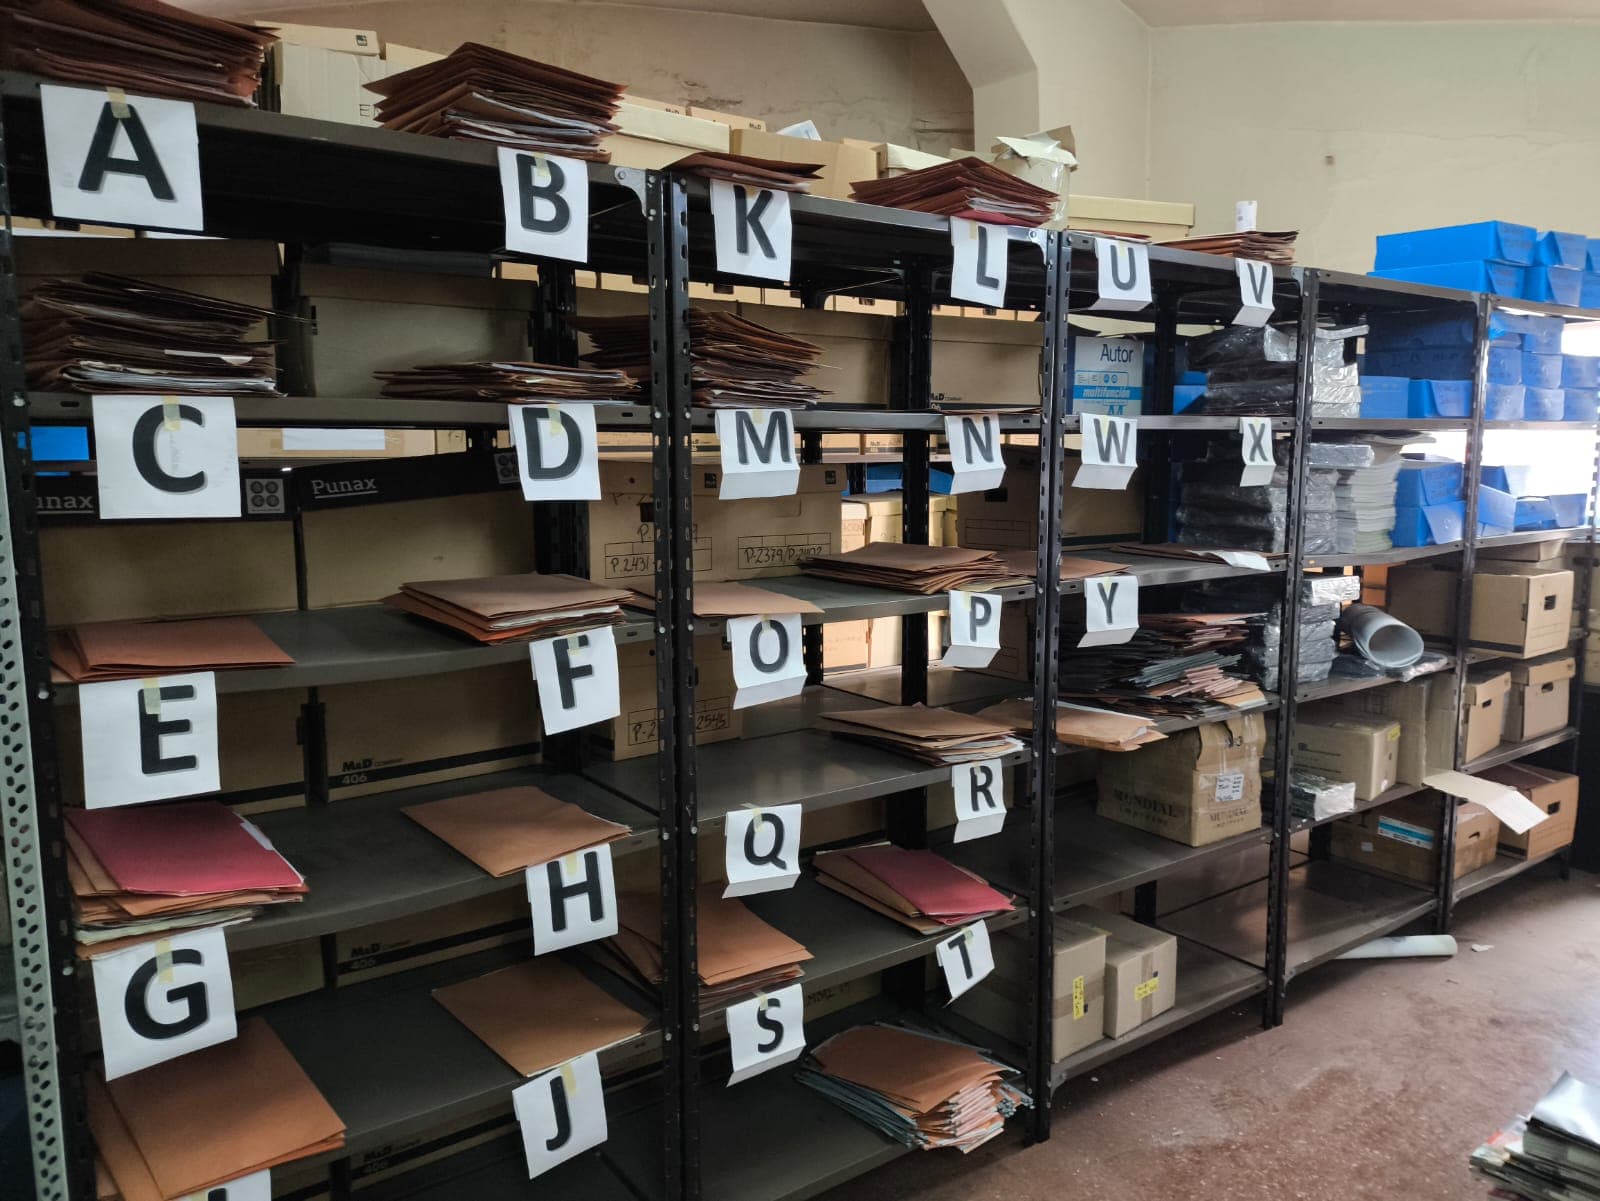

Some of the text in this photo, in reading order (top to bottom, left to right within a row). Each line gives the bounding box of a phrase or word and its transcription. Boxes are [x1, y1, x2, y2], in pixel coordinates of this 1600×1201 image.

[78, 102, 177, 200] A
[517, 153, 571, 233] B
[733, 185, 777, 259] K
[975, 226, 1000, 289] L
[1109, 244, 1136, 291] U
[1248, 264, 1268, 304] V
[1101, 344, 1134, 362] Autor
[133, 405, 207, 492] C
[521, 406, 583, 481] D
[735, 411, 792, 464] M
[963, 417, 995, 465] N
[1094, 418, 1130, 464] W
[1248, 423, 1269, 463] X
[312, 478, 377, 495] Punax
[969, 596, 992, 642] P
[1098, 581, 1120, 625] Y
[552, 634, 594, 709] F
[749, 619, 790, 673] O
[138, 685, 198, 775] E
[342, 774, 367, 785] 406
[970, 765, 997, 812] R
[744, 813, 787, 870] Q
[547, 851, 605, 932] H
[948, 933, 973, 980] T
[125, 949, 209, 1040] G
[755, 998, 784, 1053] S
[546, 1076, 572, 1151] J
